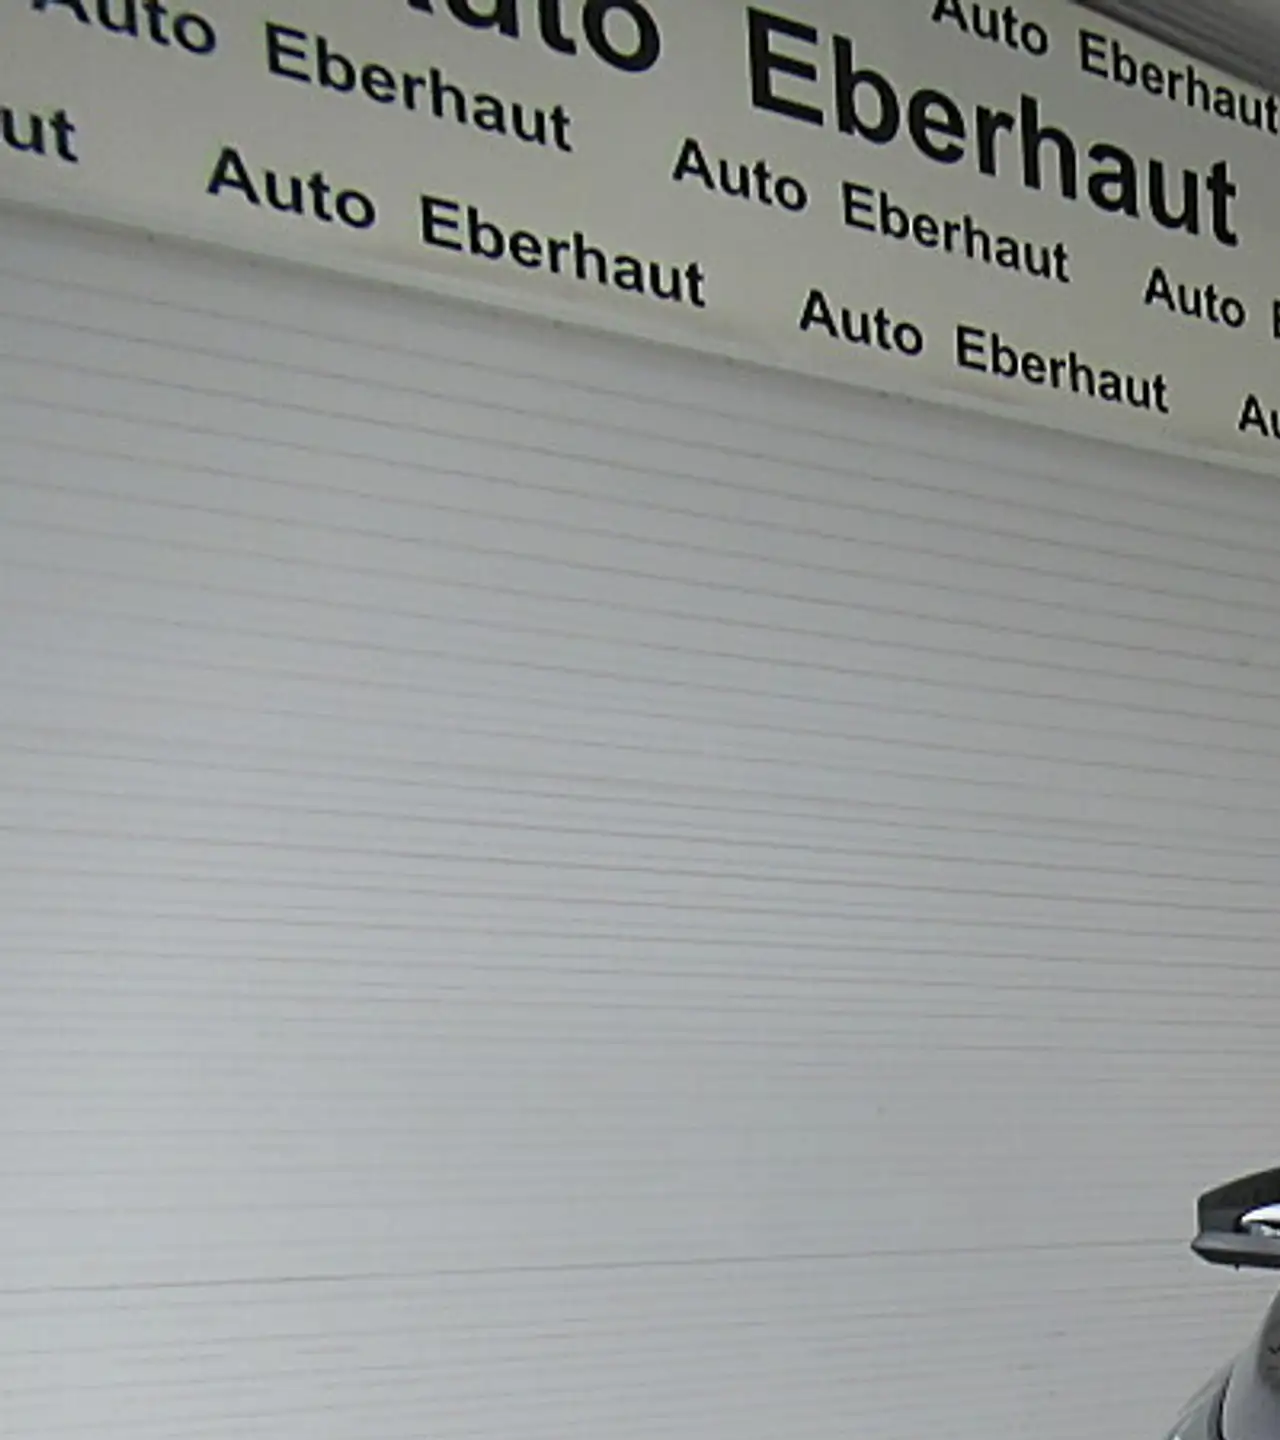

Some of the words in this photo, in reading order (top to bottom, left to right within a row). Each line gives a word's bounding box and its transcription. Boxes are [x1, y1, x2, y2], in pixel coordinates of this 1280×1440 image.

[265, 21, 573, 153] Eberhaut
[746, 6, 1238, 247] Eberhaut
[931, 0, 1048, 56] Auto
[1079, 29, 1278, 135] Eberhaut
[206, 146, 376, 229] Auto
[420, 194, 706, 309] Eberhaut
[672, 137, 808, 212] Auto
[842, 181, 1070, 284] Eberhaut
[799, 289, 923, 356] Auto
[956, 324, 1169, 414] Eberhaut
[1144, 267, 1246, 329] Auto
